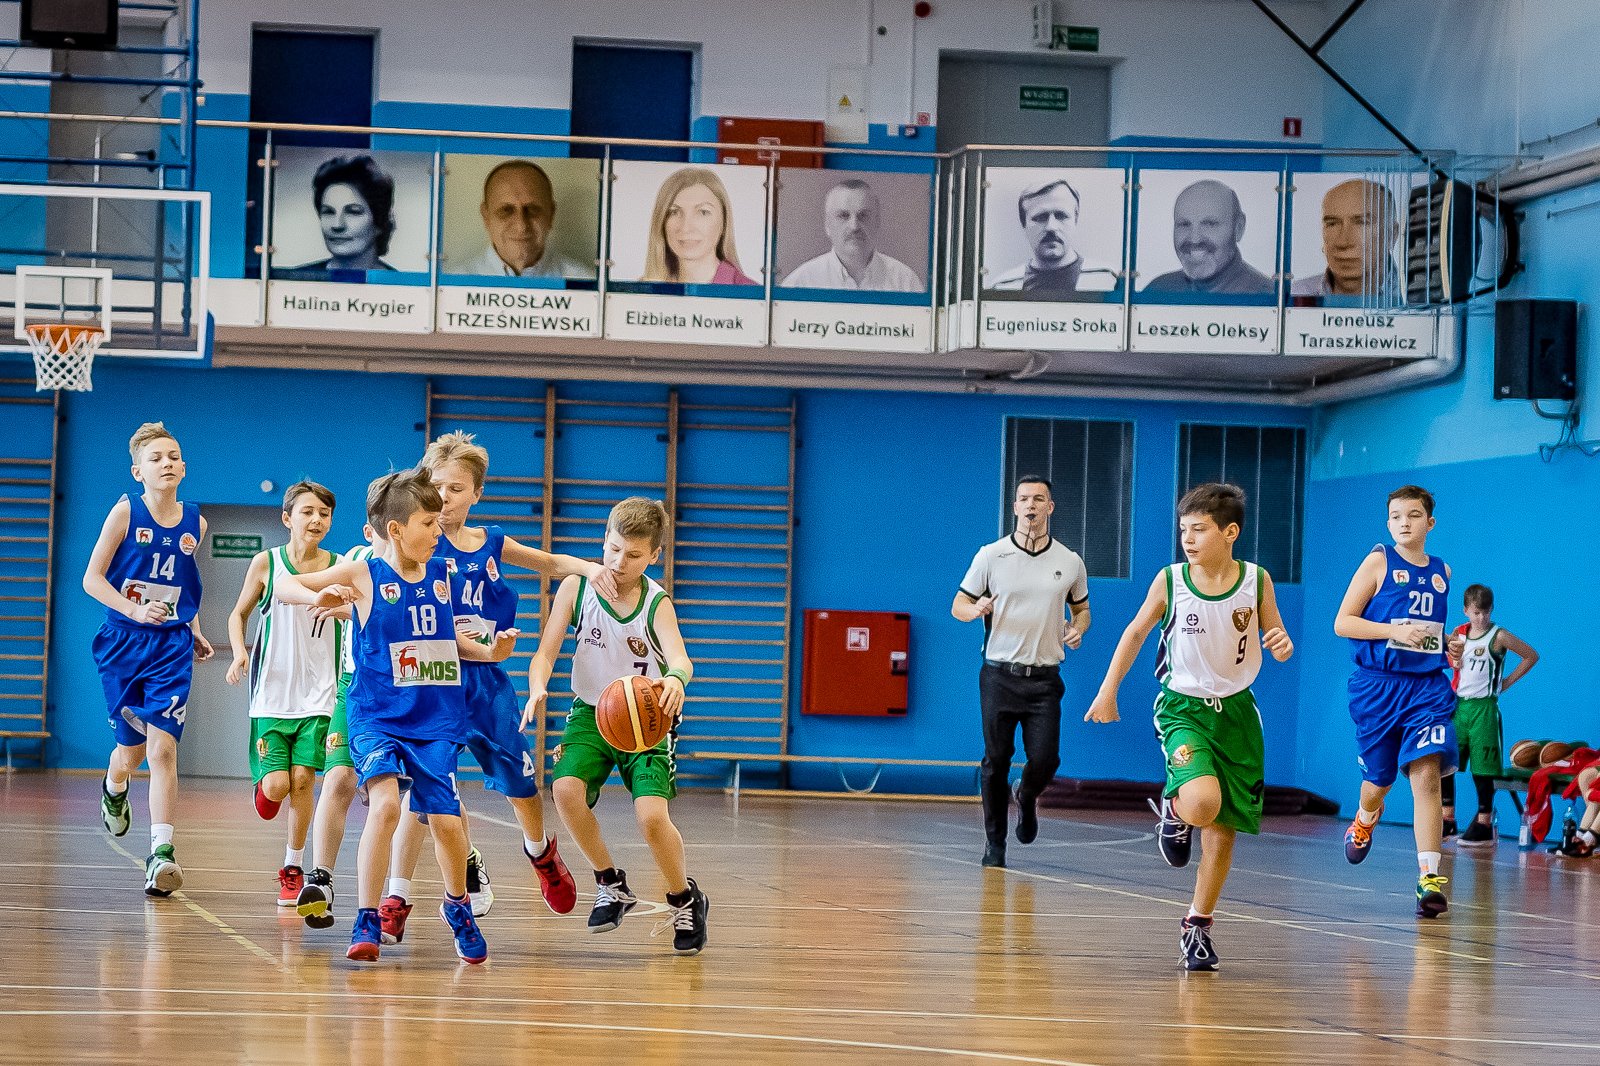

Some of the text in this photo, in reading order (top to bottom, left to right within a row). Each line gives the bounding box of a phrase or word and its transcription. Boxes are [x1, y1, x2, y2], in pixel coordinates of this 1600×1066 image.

[283, 295, 416, 318] Halina Krygier
[466, 292, 572, 311] MIROSŁAW
[446, 310, 591, 332] TRZEŚNIEWSKI
[626, 311, 744, 330] Elżbieta Nowak
[789, 319, 915, 338] Jerzy Gadzimski
[986, 317, 1118, 334] Eugeniusz Sroka
[1322, 312, 1395, 328] Ireneusz
[1137, 321, 1269, 342] Leszek Oleksy
[1299, 333, 1417, 350] Taraszkiewicz
[149, 552, 176, 581] 14
[461, 579, 485, 612] 44
[1408, 590, 1434, 617] 20
[407, 604, 437, 636] 18
[1181, 627, 1207, 635] PEHA
[584, 638, 606, 649] PEHA
[1235, 634, 1248, 665] 9
[419, 660, 457, 681] MOS
[633, 661, 648, 677] 7
[1469, 658, 1486, 672] 77
[161, 695, 187, 726] 14
[641, 686, 658, 733] molten
[1416, 724, 1446, 749] 20
